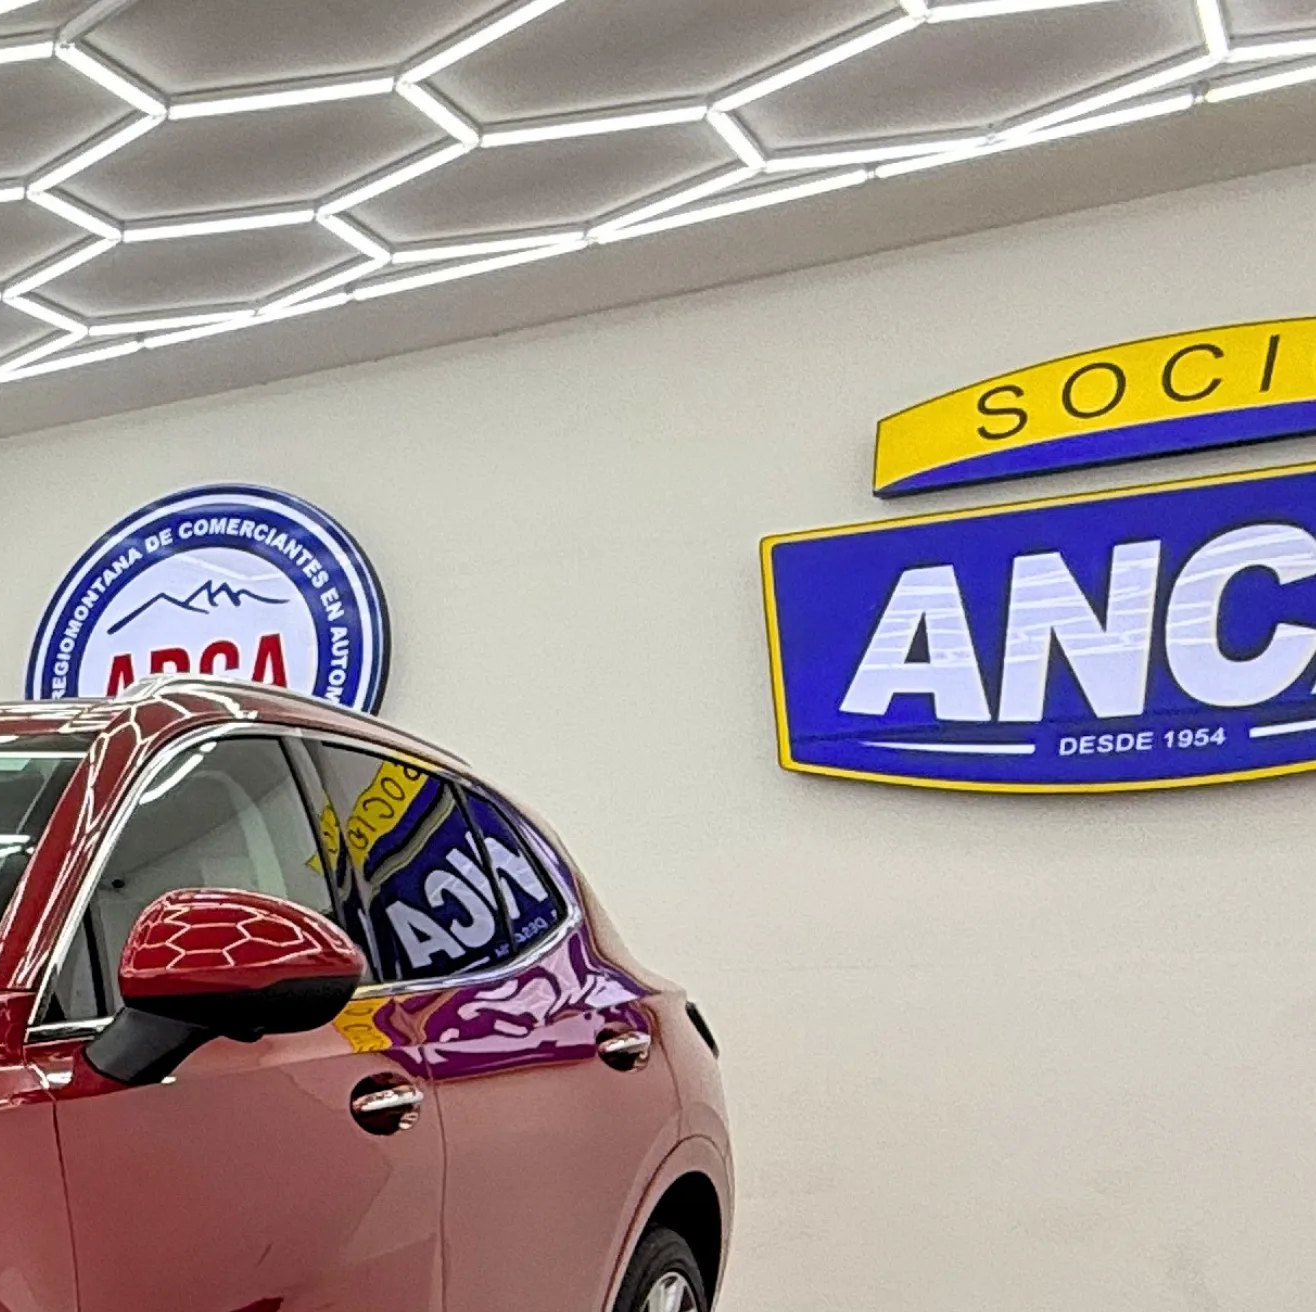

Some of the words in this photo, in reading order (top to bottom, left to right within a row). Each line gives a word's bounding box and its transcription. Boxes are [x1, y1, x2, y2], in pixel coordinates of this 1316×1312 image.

[976, 333, 1280, 440] SOCI
[144, 528, 173, 553] DE
[178, 517, 330, 589] COMERCIANTES
[320, 587, 345, 622] EN
[839, 524, 1316, 722] ANC
[1059, 731, 1154, 756] DESDE
[1164, 727, 1227, 748] 1954
